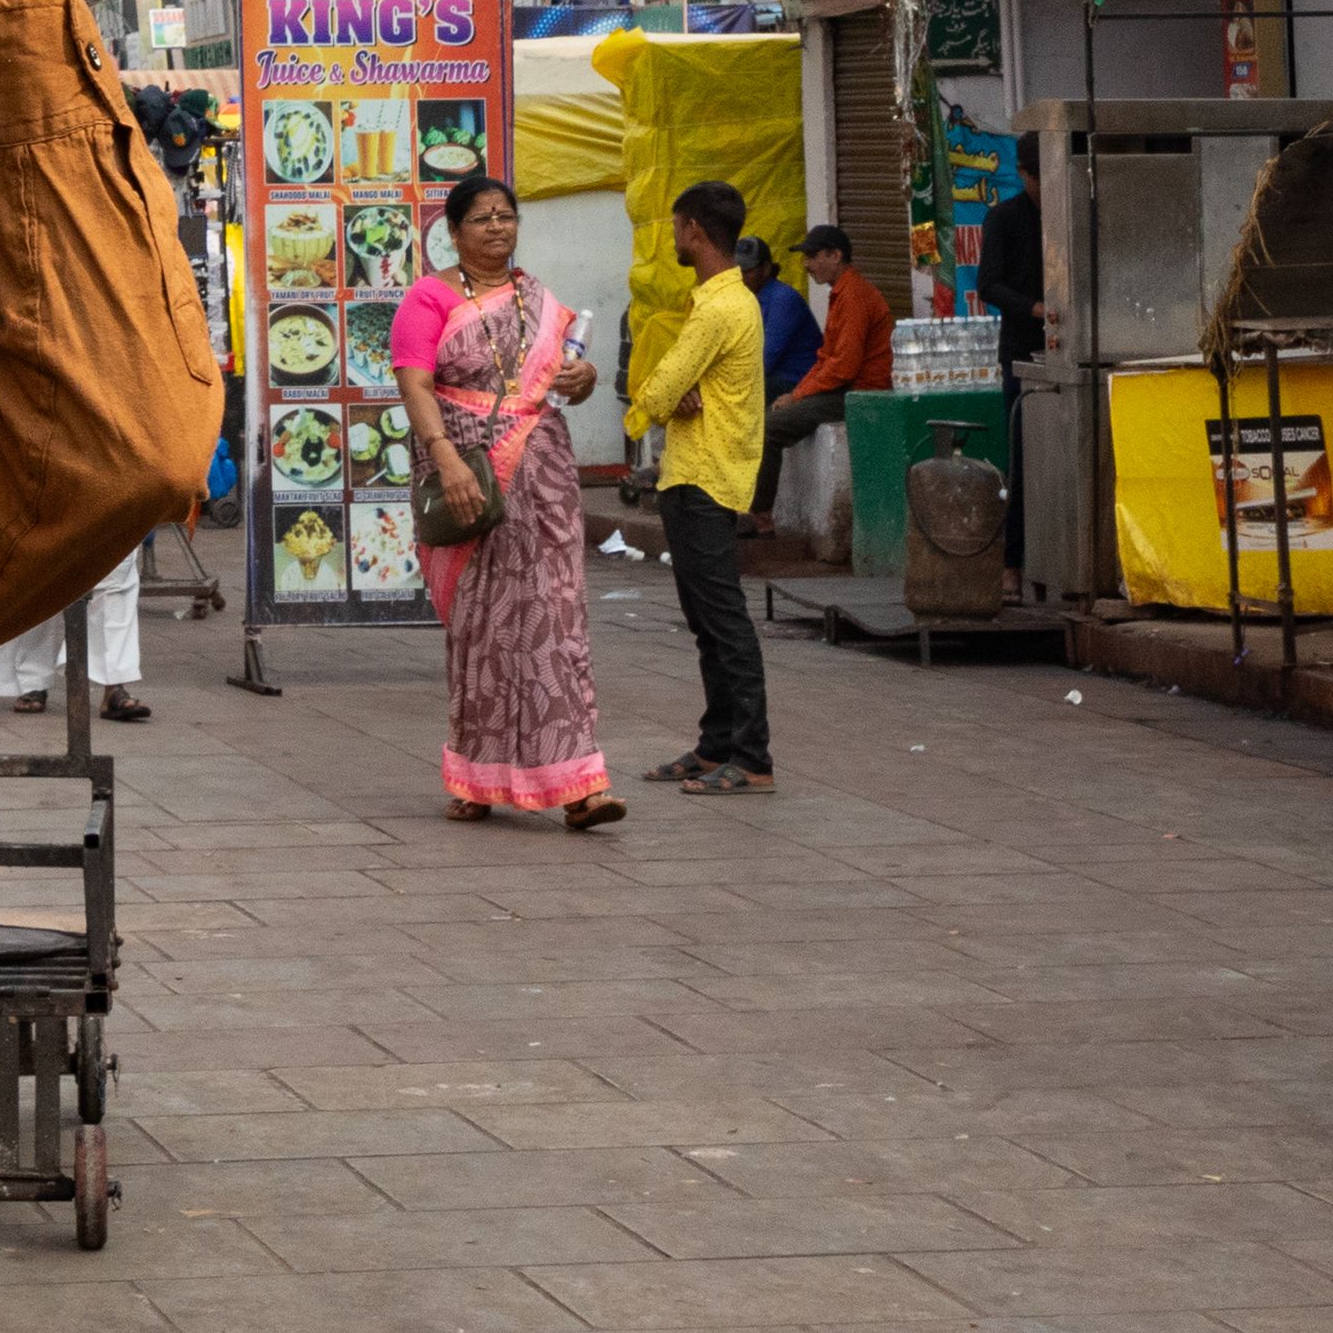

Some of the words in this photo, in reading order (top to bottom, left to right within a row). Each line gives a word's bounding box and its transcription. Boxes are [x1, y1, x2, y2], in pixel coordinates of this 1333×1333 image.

[256, 50, 326, 88] Juice
[329, 63, 344, 83] &
[349, 49, 490, 85] Shawarma
[354, 289, 376, 299] FRUIT
